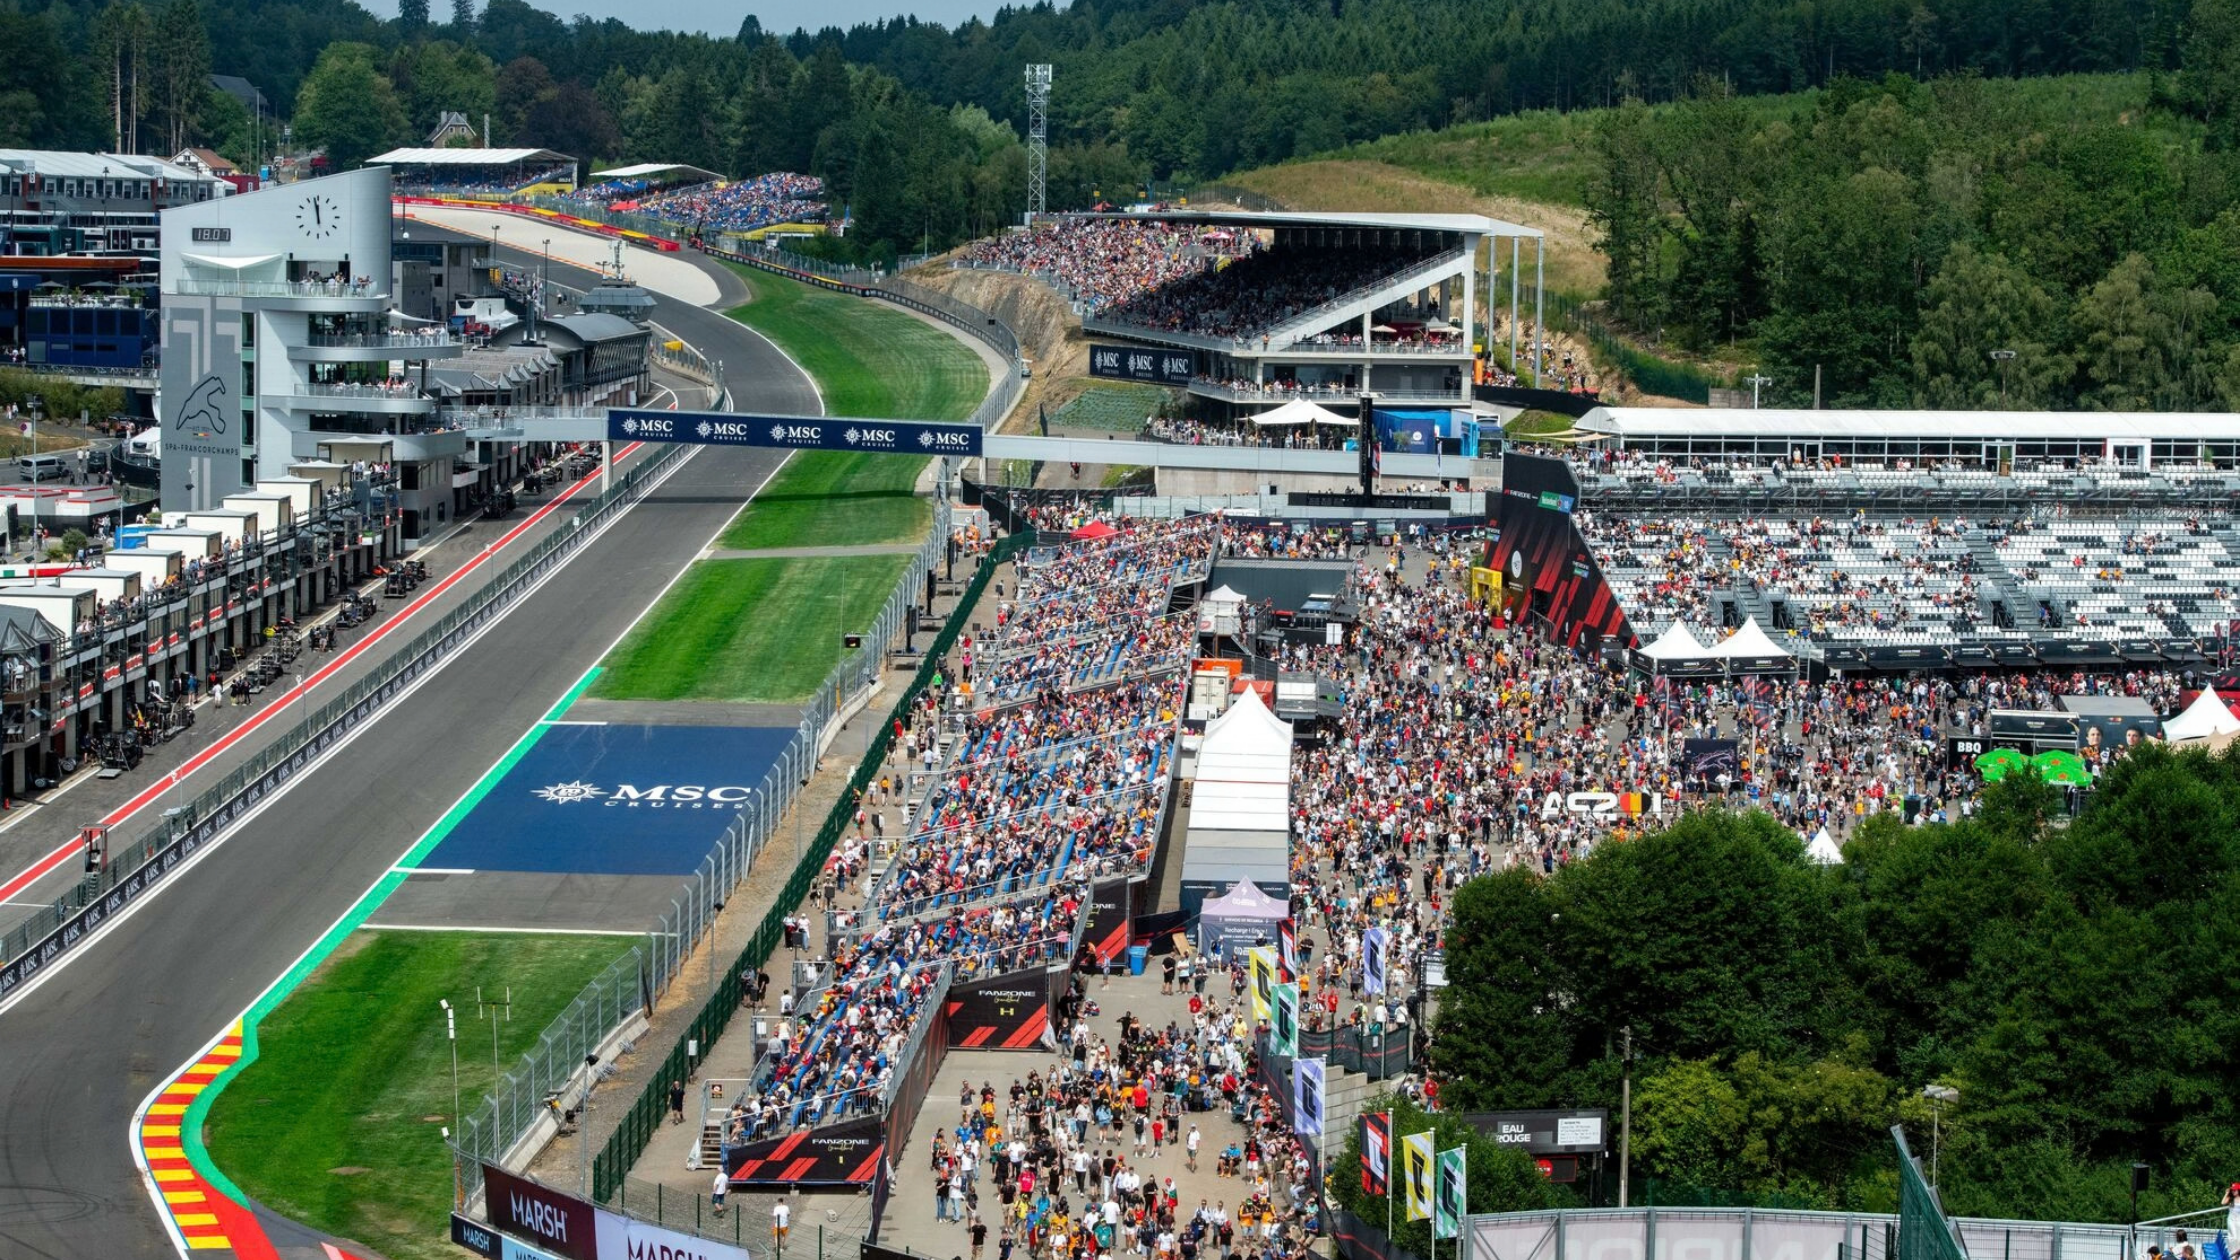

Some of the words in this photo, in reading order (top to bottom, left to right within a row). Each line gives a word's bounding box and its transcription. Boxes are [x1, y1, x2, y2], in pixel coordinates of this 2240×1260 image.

[1103, 352, 1119, 367] MSC
[1136, 355, 1153, 370] MSC
[1171, 358, 1188, 374] MSC
[640, 419, 673, 432] MSC
[714, 422, 747, 436] MSC
[788, 426, 821, 438] MSC
[862, 430, 895, 442] MSC
[936, 432, 969, 445] MSC
[165, 443, 238, 456] SPA-FRANCORCHAMPS
[1958, 742, 1982, 754] BBQ
[609, 785, 750, 801] MSC
[2, 968, 16, 989] MSC
[1000, 1008, 1014, 1016] H
[1502, 1124, 1524, 1134] EAU
[510, 1188, 568, 1242] MARSH
[463, 1226, 490, 1252] MARSH
